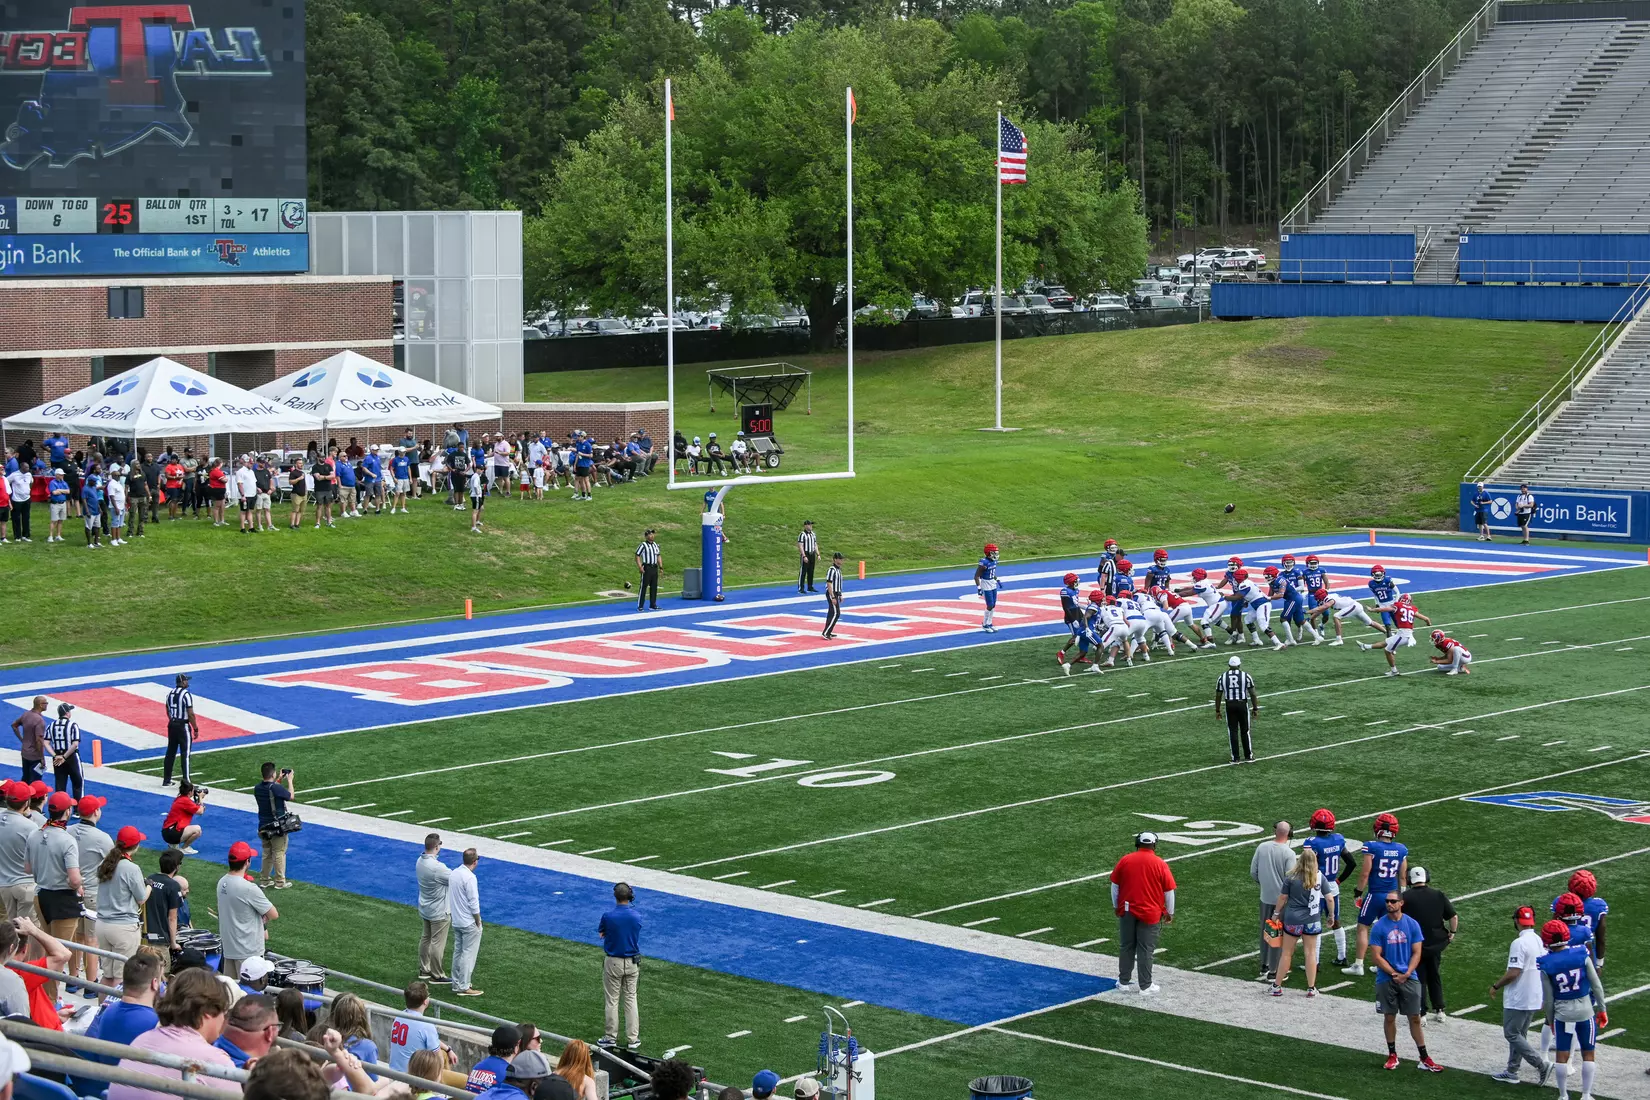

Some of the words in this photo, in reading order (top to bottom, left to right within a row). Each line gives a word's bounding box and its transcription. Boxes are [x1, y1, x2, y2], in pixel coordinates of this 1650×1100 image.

[25, 199, 53, 210] DOWN
[62, 199, 74, 210] TO
[76, 199, 88, 210] GO
[146, 199, 166, 210] BALL
[168, 199, 181, 210] ON
[189, 199, 207, 211] QTR
[223, 205, 231, 215] 3
[103, 203, 133, 225] 25
[185, 214, 207, 225] 1ST
[251, 208, 269, 222] 17
[221, 218, 236, 229] TOL
[32, 242, 82, 264] Bank
[113, 248, 130, 257] The
[132, 247, 165, 257] Official
[167, 247, 189, 257] Bank
[191, 247, 201, 257] of
[253, 246, 291, 256] Athletics
[284, 396, 324, 411] Bank
[340, 397, 407, 414] Origin
[406, 392, 462, 407] Bank
[42, 404, 90, 419] Origin
[91, 406, 136, 421] Bank
[150, 404, 221, 421] Origin
[222, 402, 280, 416] Bank
[749, 419, 771, 433] 5:00
[1532, 503, 1570, 524] rigin
[1576, 504, 1618, 523] Bank
[1310, 577, 1320, 588] 39
[1378, 590, 1388, 600] 21
[1400, 607, 1415, 623] 36
[228, 564, 1411, 706] BULLDO
[1228, 675, 1240, 688] R
[55, 726, 66, 740] H
[704, 757, 897, 788] 10
[1325, 855, 1339, 876] 10
[1378, 859, 1400, 878] 52
[1555, 969, 1582, 993] 27
[391, 1021, 409, 1046] 20
